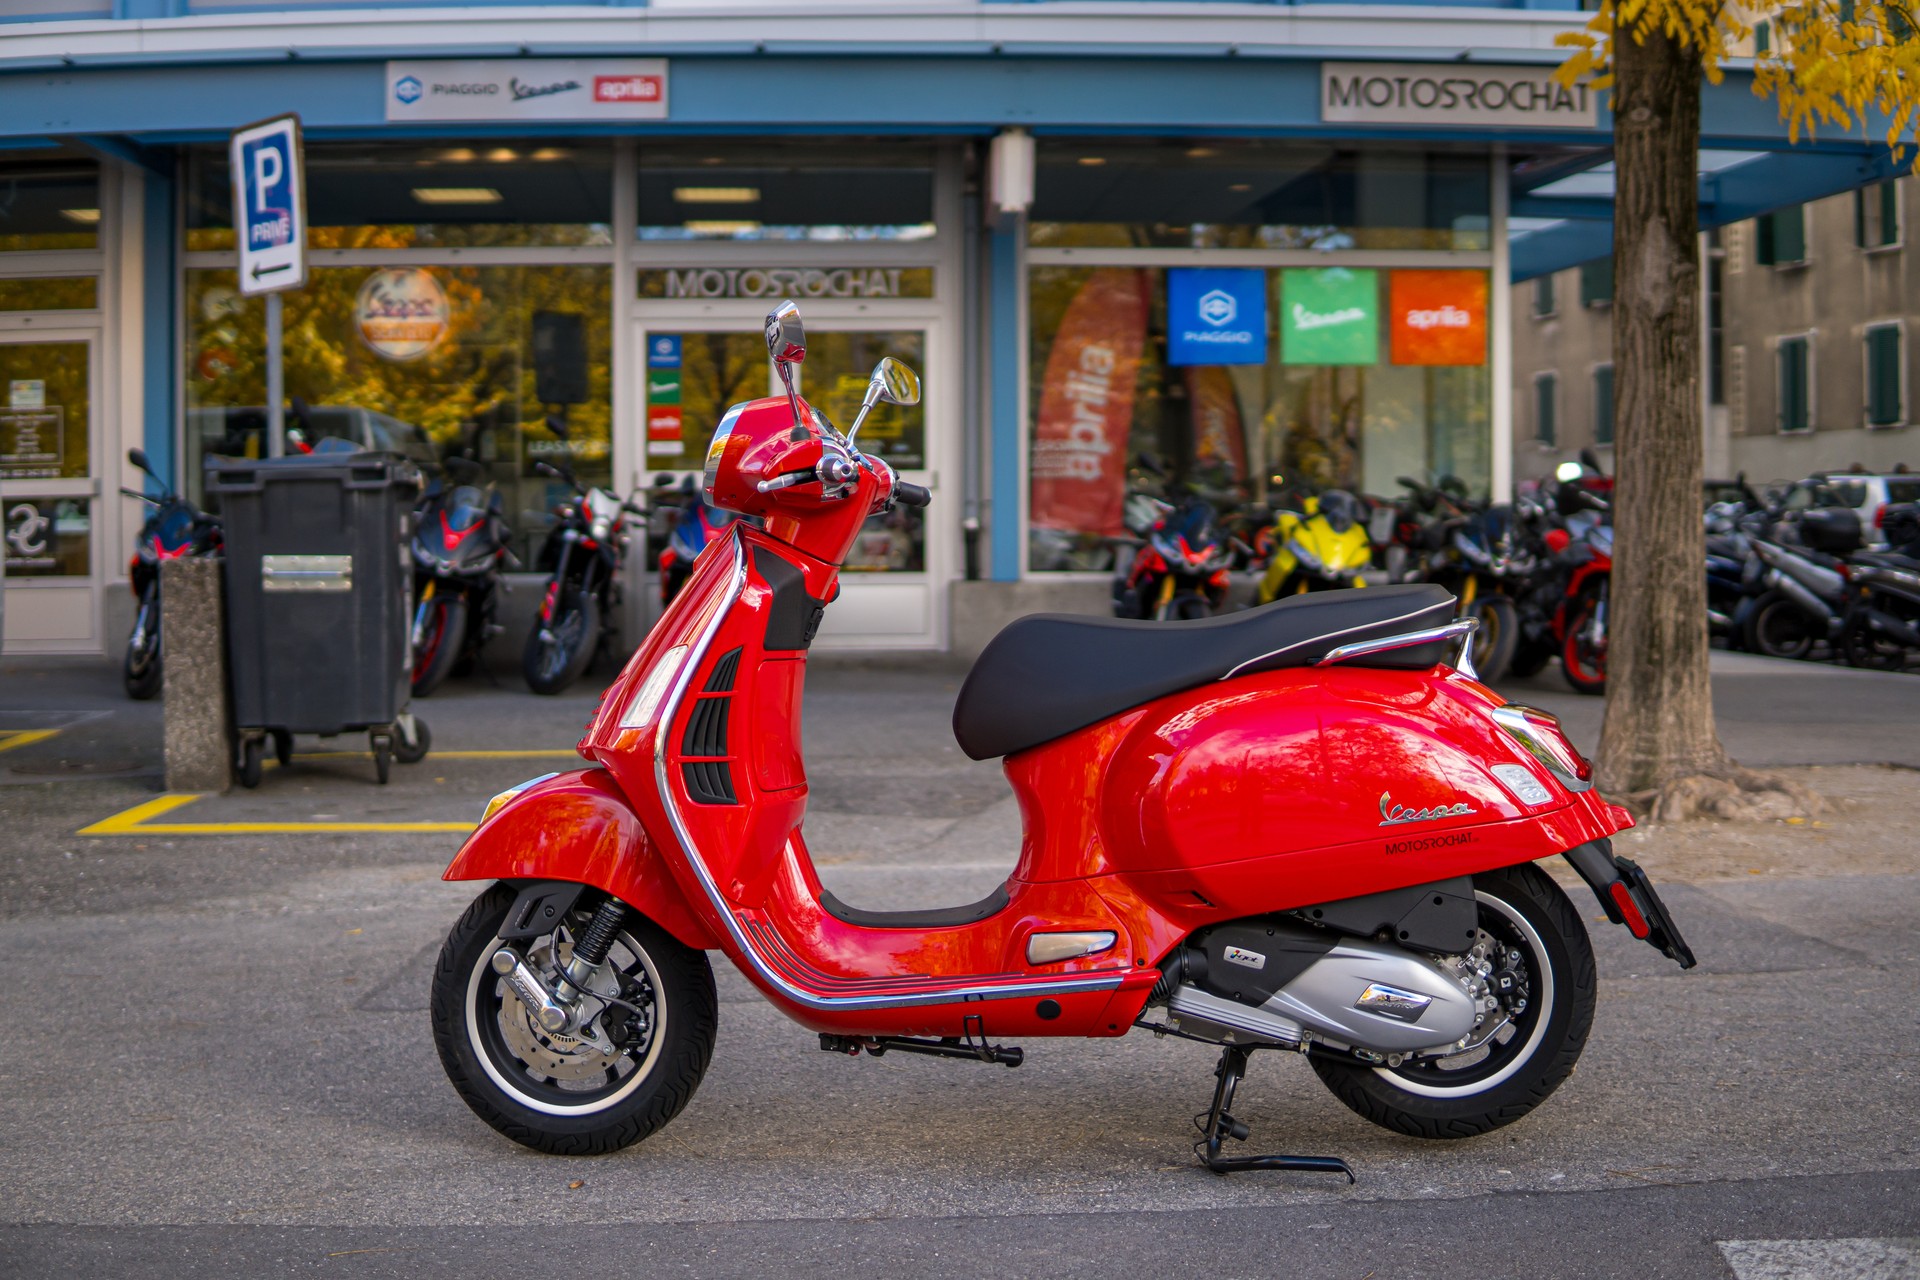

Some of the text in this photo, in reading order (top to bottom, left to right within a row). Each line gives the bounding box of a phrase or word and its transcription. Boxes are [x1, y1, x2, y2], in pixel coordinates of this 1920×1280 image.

[431, 83, 500, 96] PIAGGIO
[601, 79, 658, 98] aprilia
[1328, 75, 1590, 112] MOTOSROCHAT
[255, 146, 283, 213] P
[665, 268, 902, 298] MOTOSROCHAT
[1407, 305, 1471, 330] aprilia
[1183, 331, 1252, 344] PIAGGIO
[1063, 345, 1115, 481] aprilia
[1379, 791, 1477, 827] Vespa
[1385, 832, 1472, 856] MOTOSROCHAT
